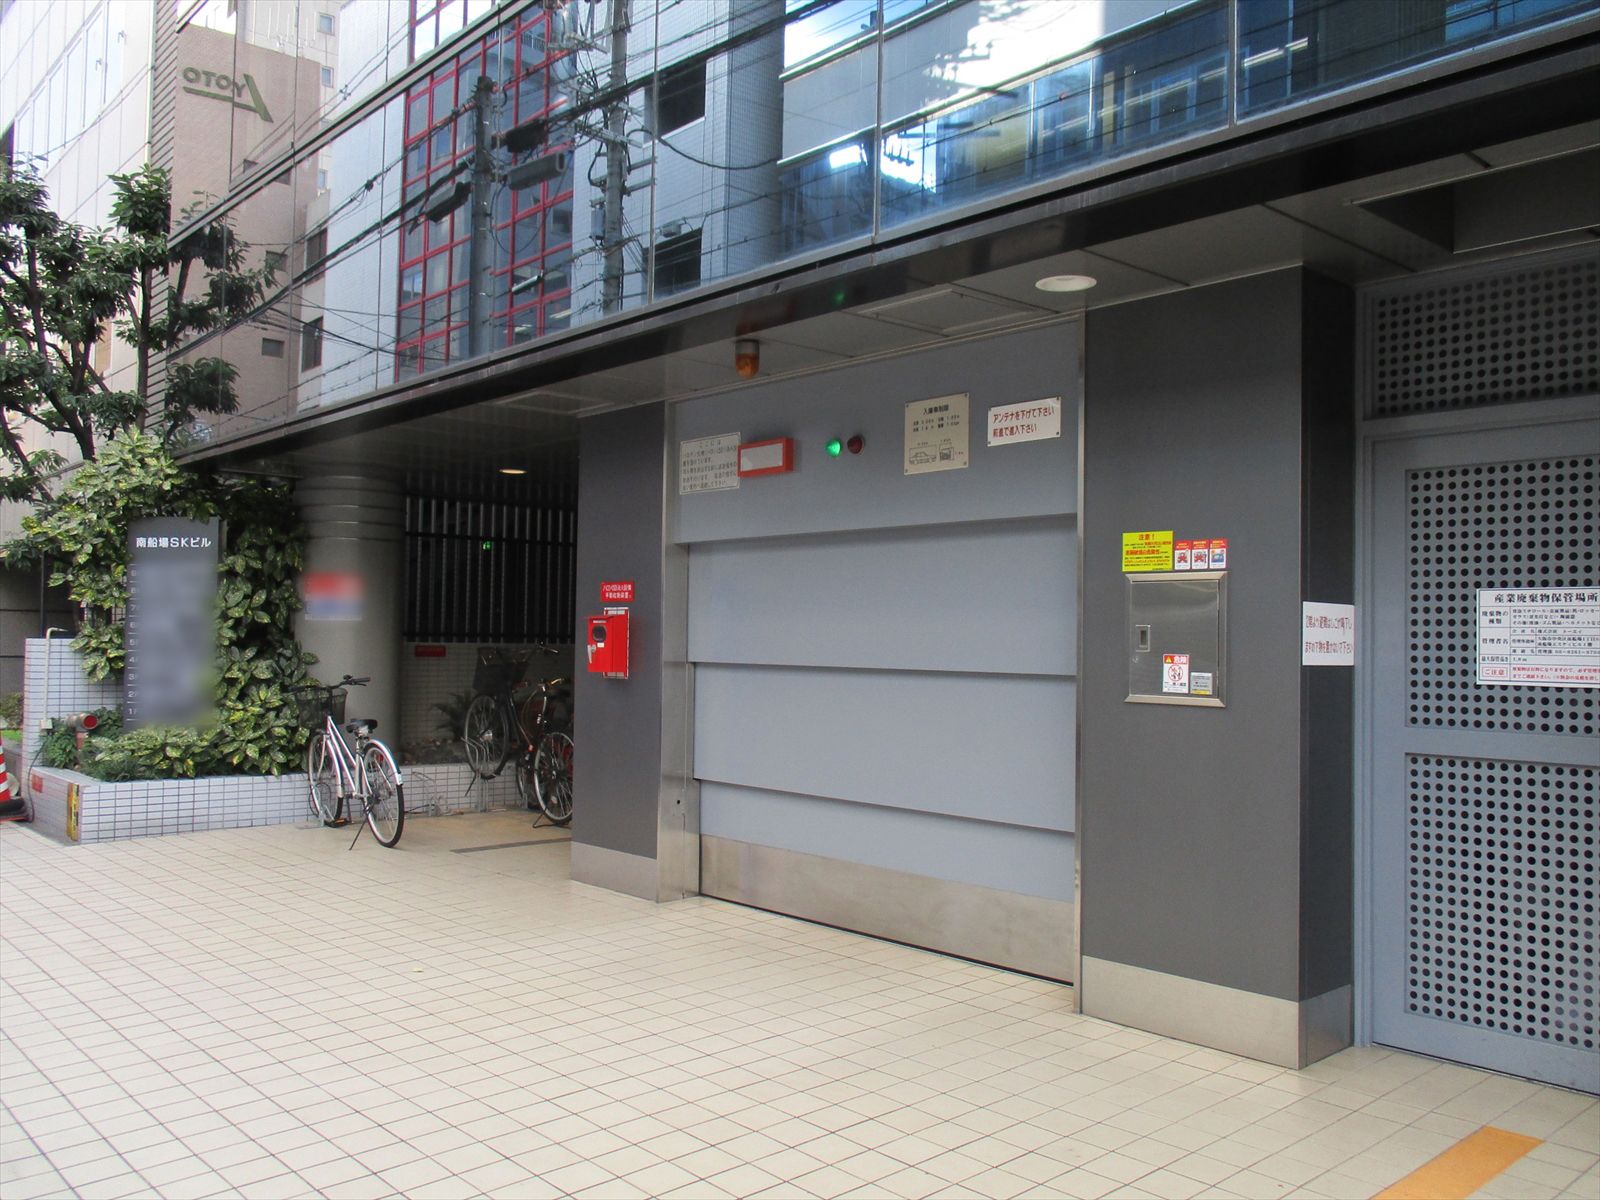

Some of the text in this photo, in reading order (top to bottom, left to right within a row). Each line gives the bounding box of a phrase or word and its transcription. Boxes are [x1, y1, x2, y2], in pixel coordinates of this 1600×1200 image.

[993, 406, 1055, 424] アンテナを下げて下さい
[136, 537, 212, 549] 南船場SKビル
[1494, 592, 1599, 603] 産業廃棄物保管場所
